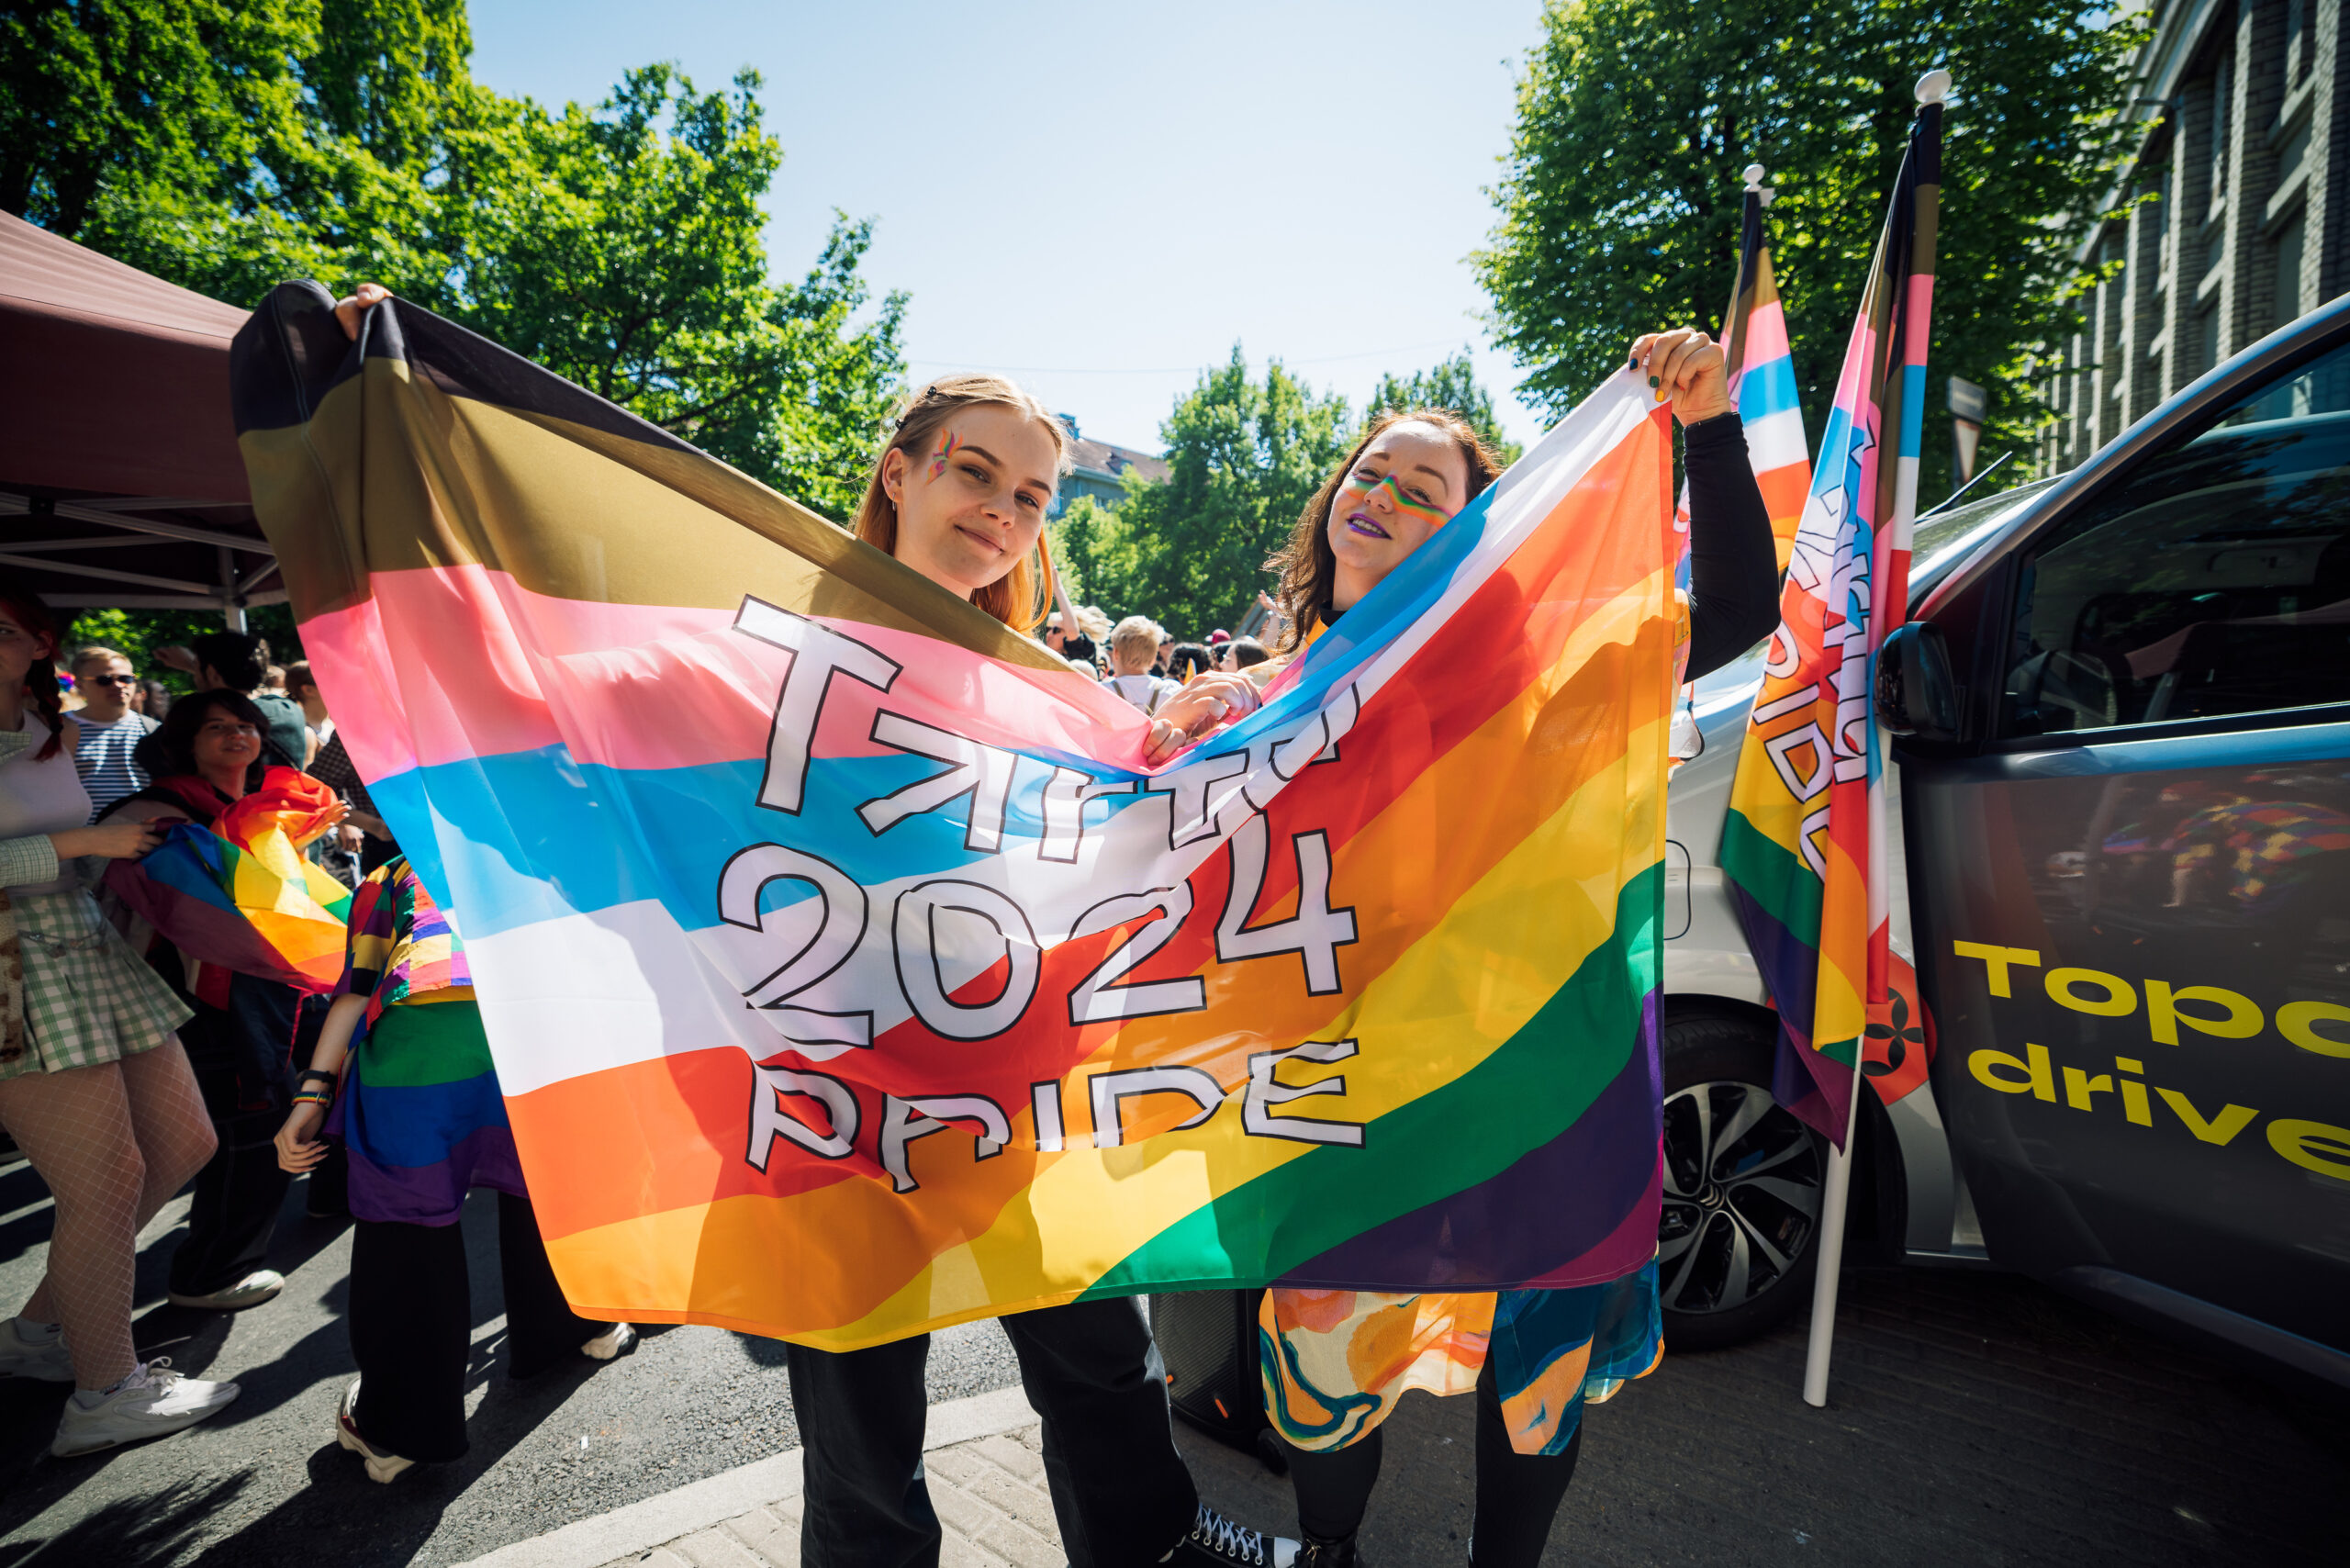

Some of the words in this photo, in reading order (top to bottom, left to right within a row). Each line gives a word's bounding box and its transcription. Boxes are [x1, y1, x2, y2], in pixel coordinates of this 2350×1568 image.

[718, 810, 1360, 1049] 2024
[744, 1038, 1367, 1193] PRIDE
[1967, 1042, 2350, 1182] drive
